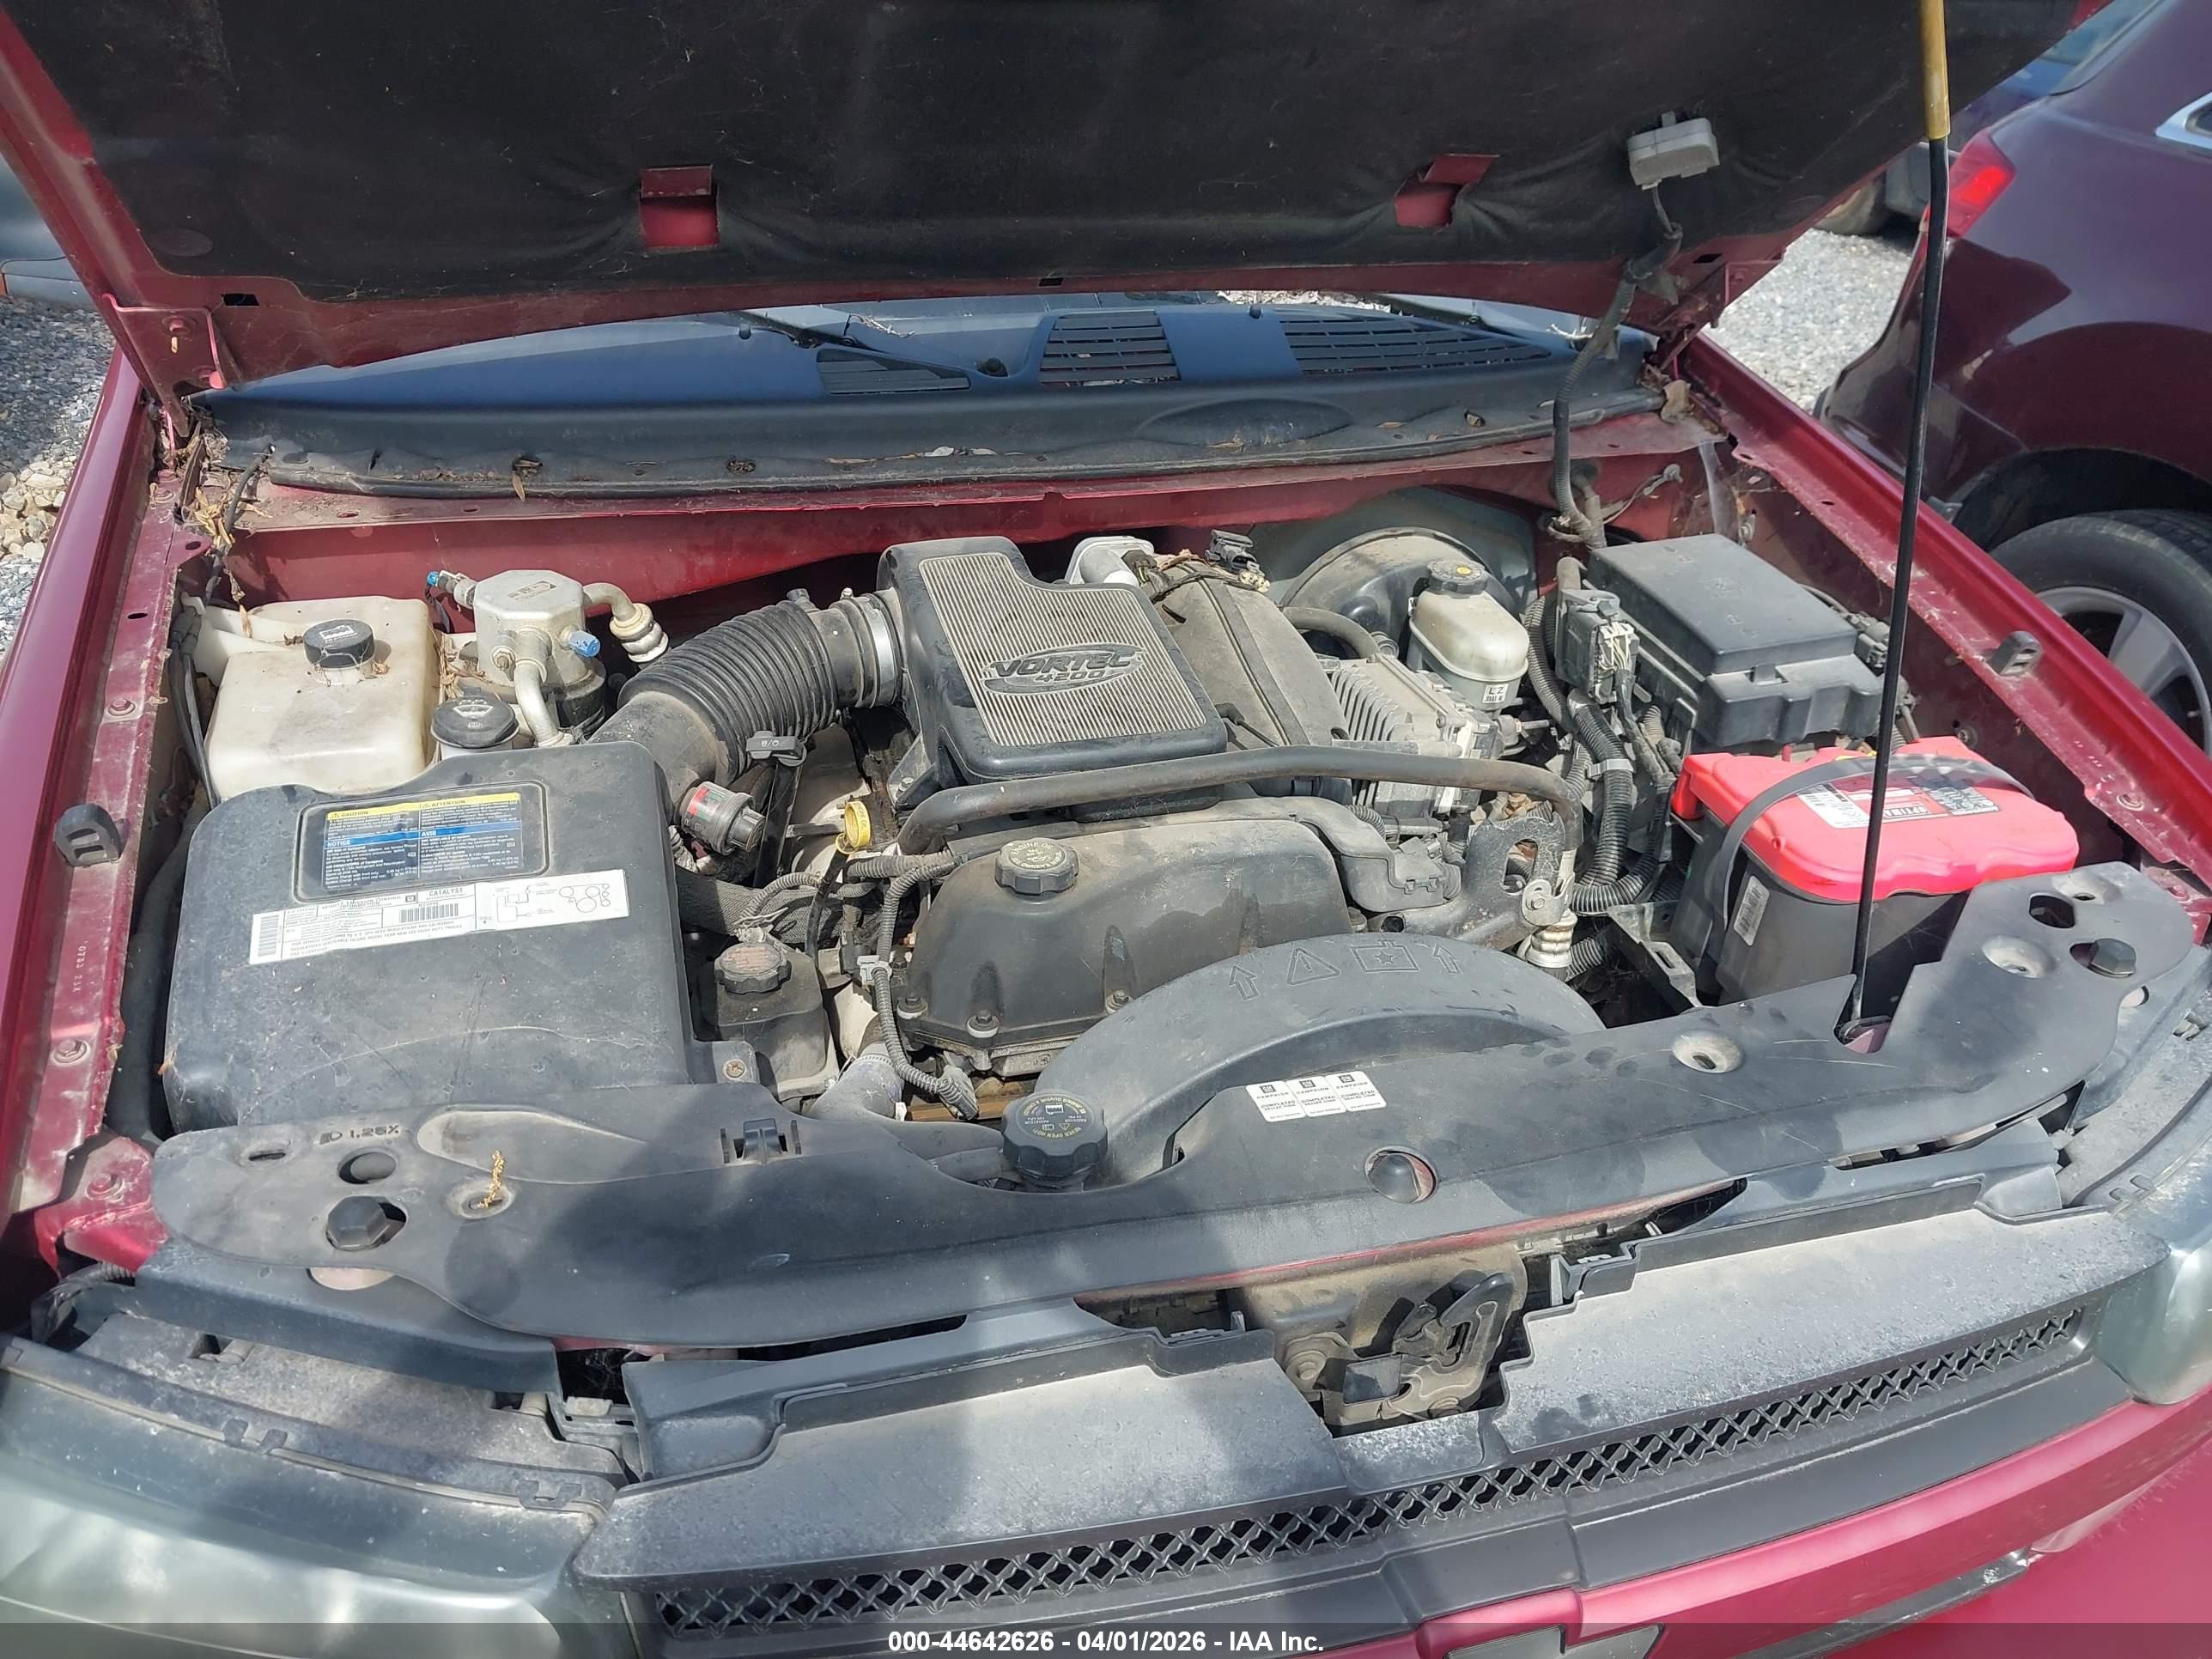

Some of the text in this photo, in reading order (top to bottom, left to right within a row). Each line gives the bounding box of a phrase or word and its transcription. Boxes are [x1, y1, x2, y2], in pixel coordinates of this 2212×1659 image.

[990, 651, 1133, 677] VORTEC
[1035, 669, 1105, 683] 4200
[1010, 842, 1039, 855] ENGINE
[429, 887, 464, 896] CATALYST
[1301, 1095, 1336, 1103] COMPLETED
[1340, 1090, 1375, 1098] COMPLETED
